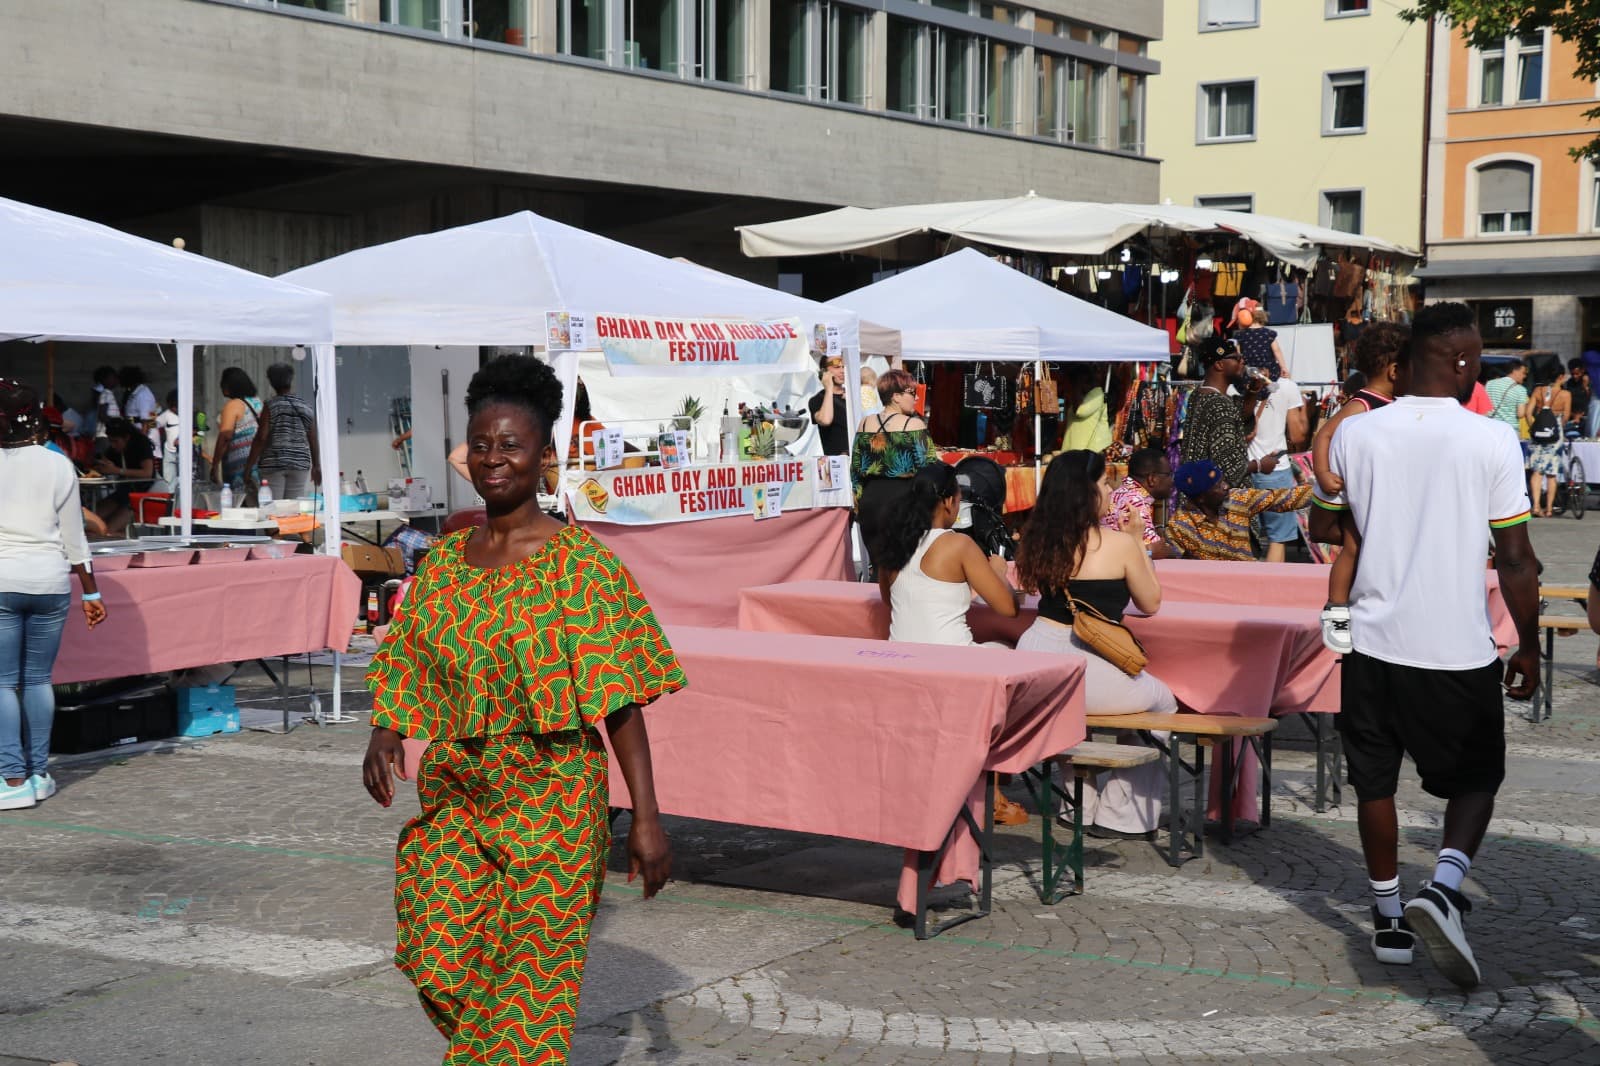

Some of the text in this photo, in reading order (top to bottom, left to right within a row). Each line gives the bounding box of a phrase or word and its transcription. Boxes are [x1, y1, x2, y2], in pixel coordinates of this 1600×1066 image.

[596, 316, 653, 339] GHANA
[655, 321, 688, 341] DAY
[690, 323, 725, 341] AND
[724, 323, 798, 340] HIGHLIFE
[669, 341, 740, 361] FESTIVAL
[613, 474, 667, 497] GHANA
[672, 470, 703, 492] DAY
[707, 467, 736, 490] AND
[742, 462, 804, 486] HIGHLIFE
[680, 488, 746, 514] FESTIVAL
